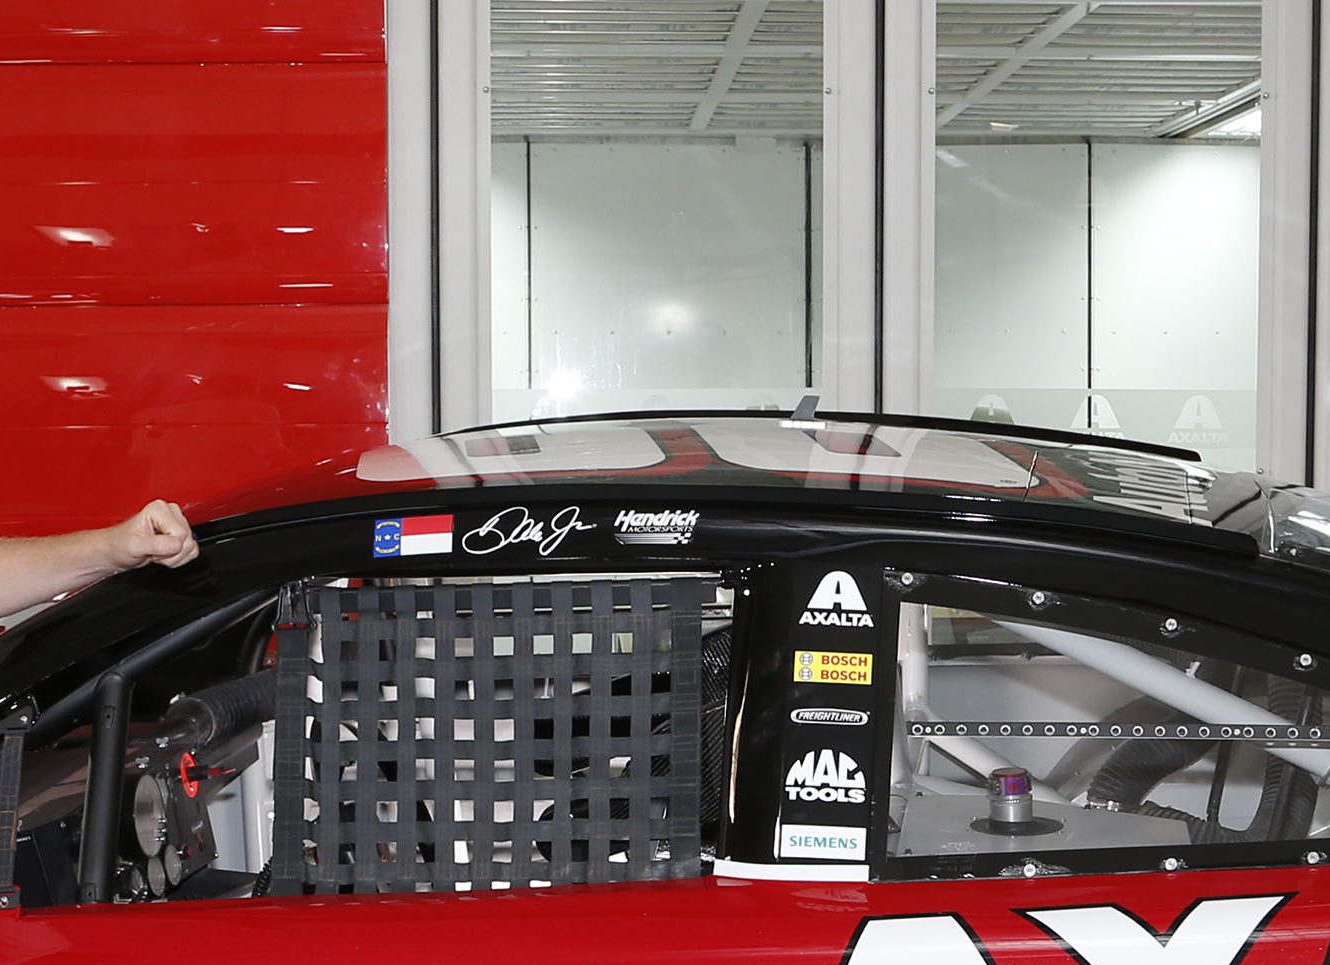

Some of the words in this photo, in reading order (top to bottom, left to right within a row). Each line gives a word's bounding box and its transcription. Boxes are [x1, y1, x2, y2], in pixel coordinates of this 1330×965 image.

[614, 510, 700, 532] Hendrick
[798, 611, 875, 628] AXALTA
[821, 655, 868, 667] BOSCH
[820, 669, 867, 681] BOSCH
[798, 711, 861, 723] FREIGHTLINER
[785, 749, 866, 788] MAC
[785, 786, 866, 804] TOOLS
[789, 836, 858, 849] SIEMENS
